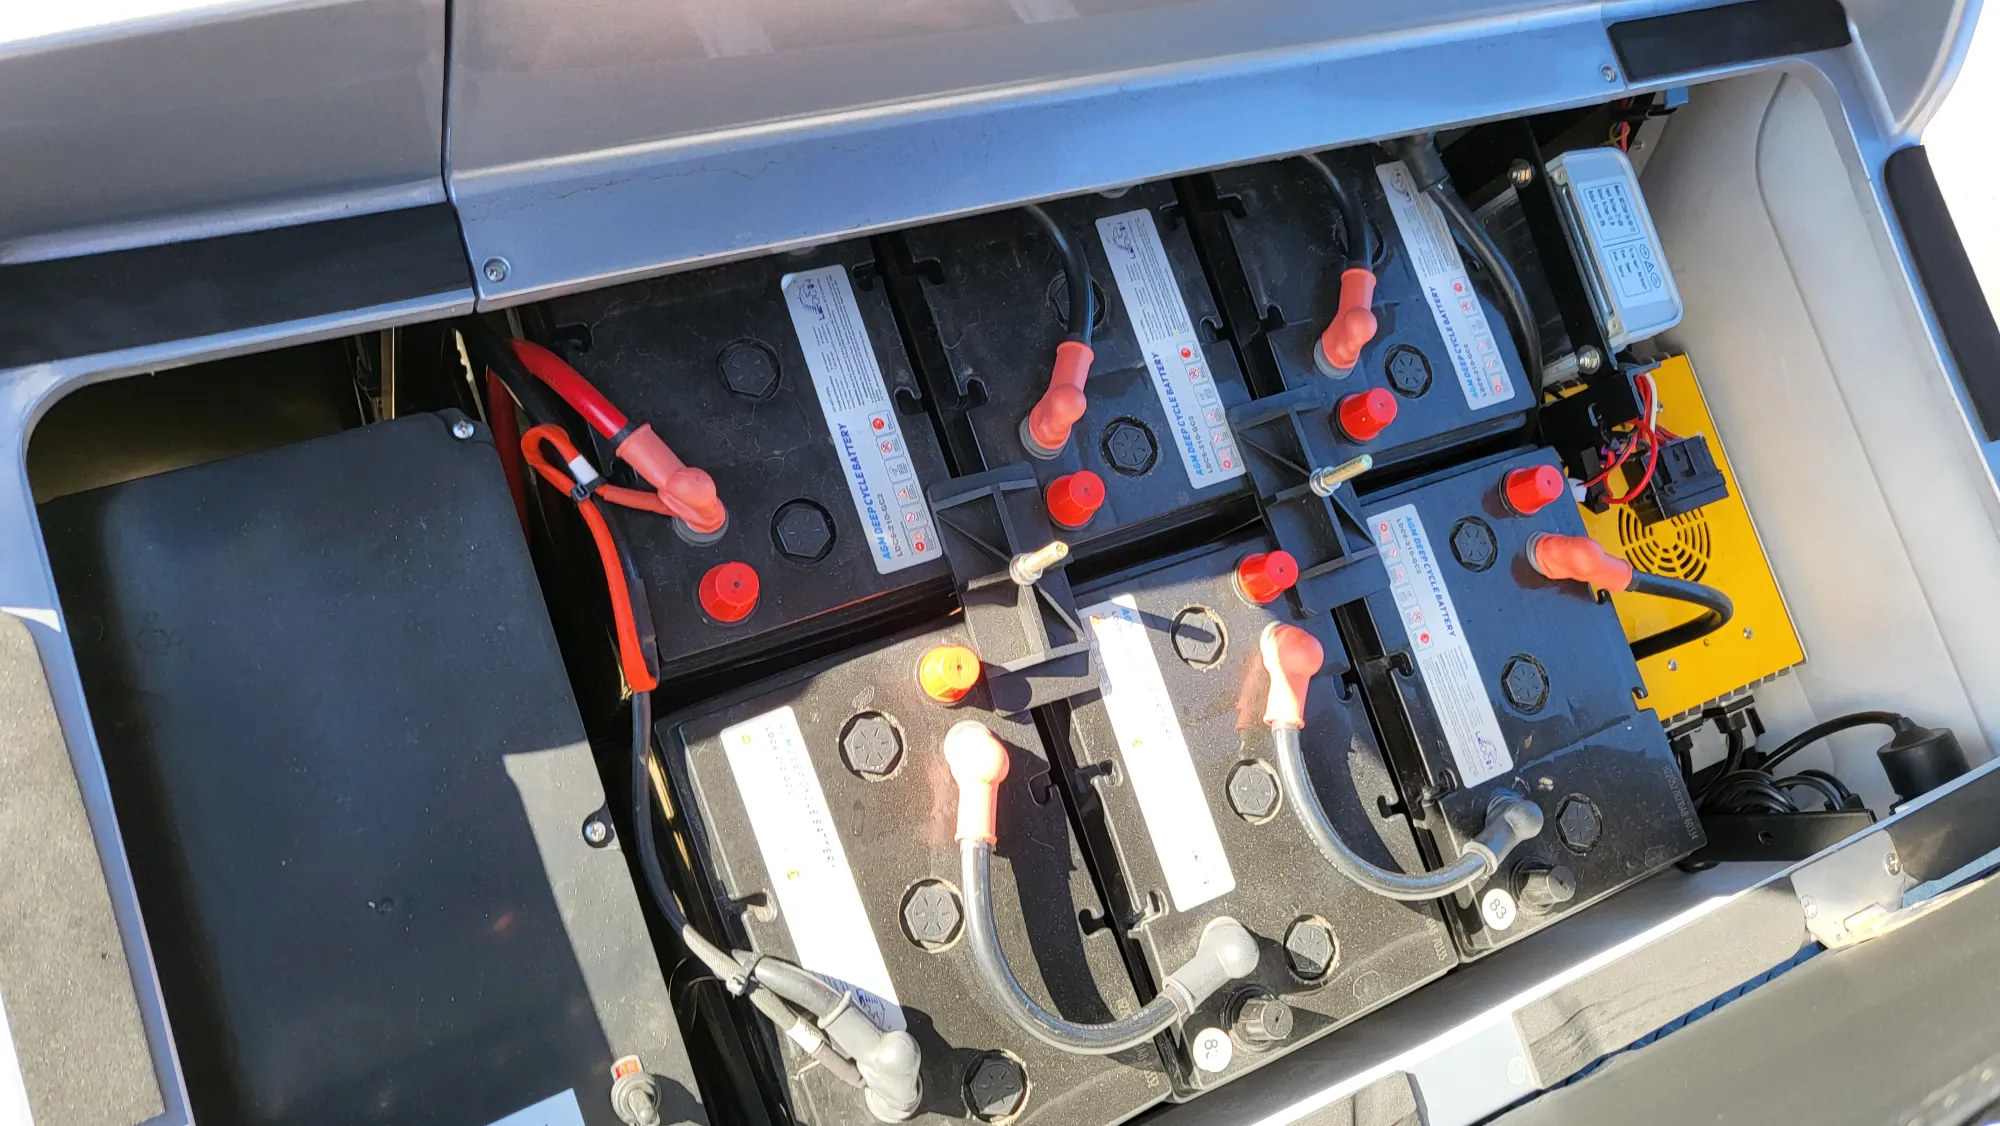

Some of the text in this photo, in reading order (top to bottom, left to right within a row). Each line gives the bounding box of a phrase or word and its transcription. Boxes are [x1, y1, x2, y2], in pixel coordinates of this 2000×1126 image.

[1429, 285, 1478, 399] AGM DEEP CYCLE BATTERY
[1151, 350, 1203, 476] AGM DEEP CYCLE BATTERY
[837, 421, 892, 561] AGM DEEP CYCLE BATTERY
[1404, 515, 1456, 638] AGM DEEP CYCLE BATTERY
[1488, 898, 1508, 921] 83
